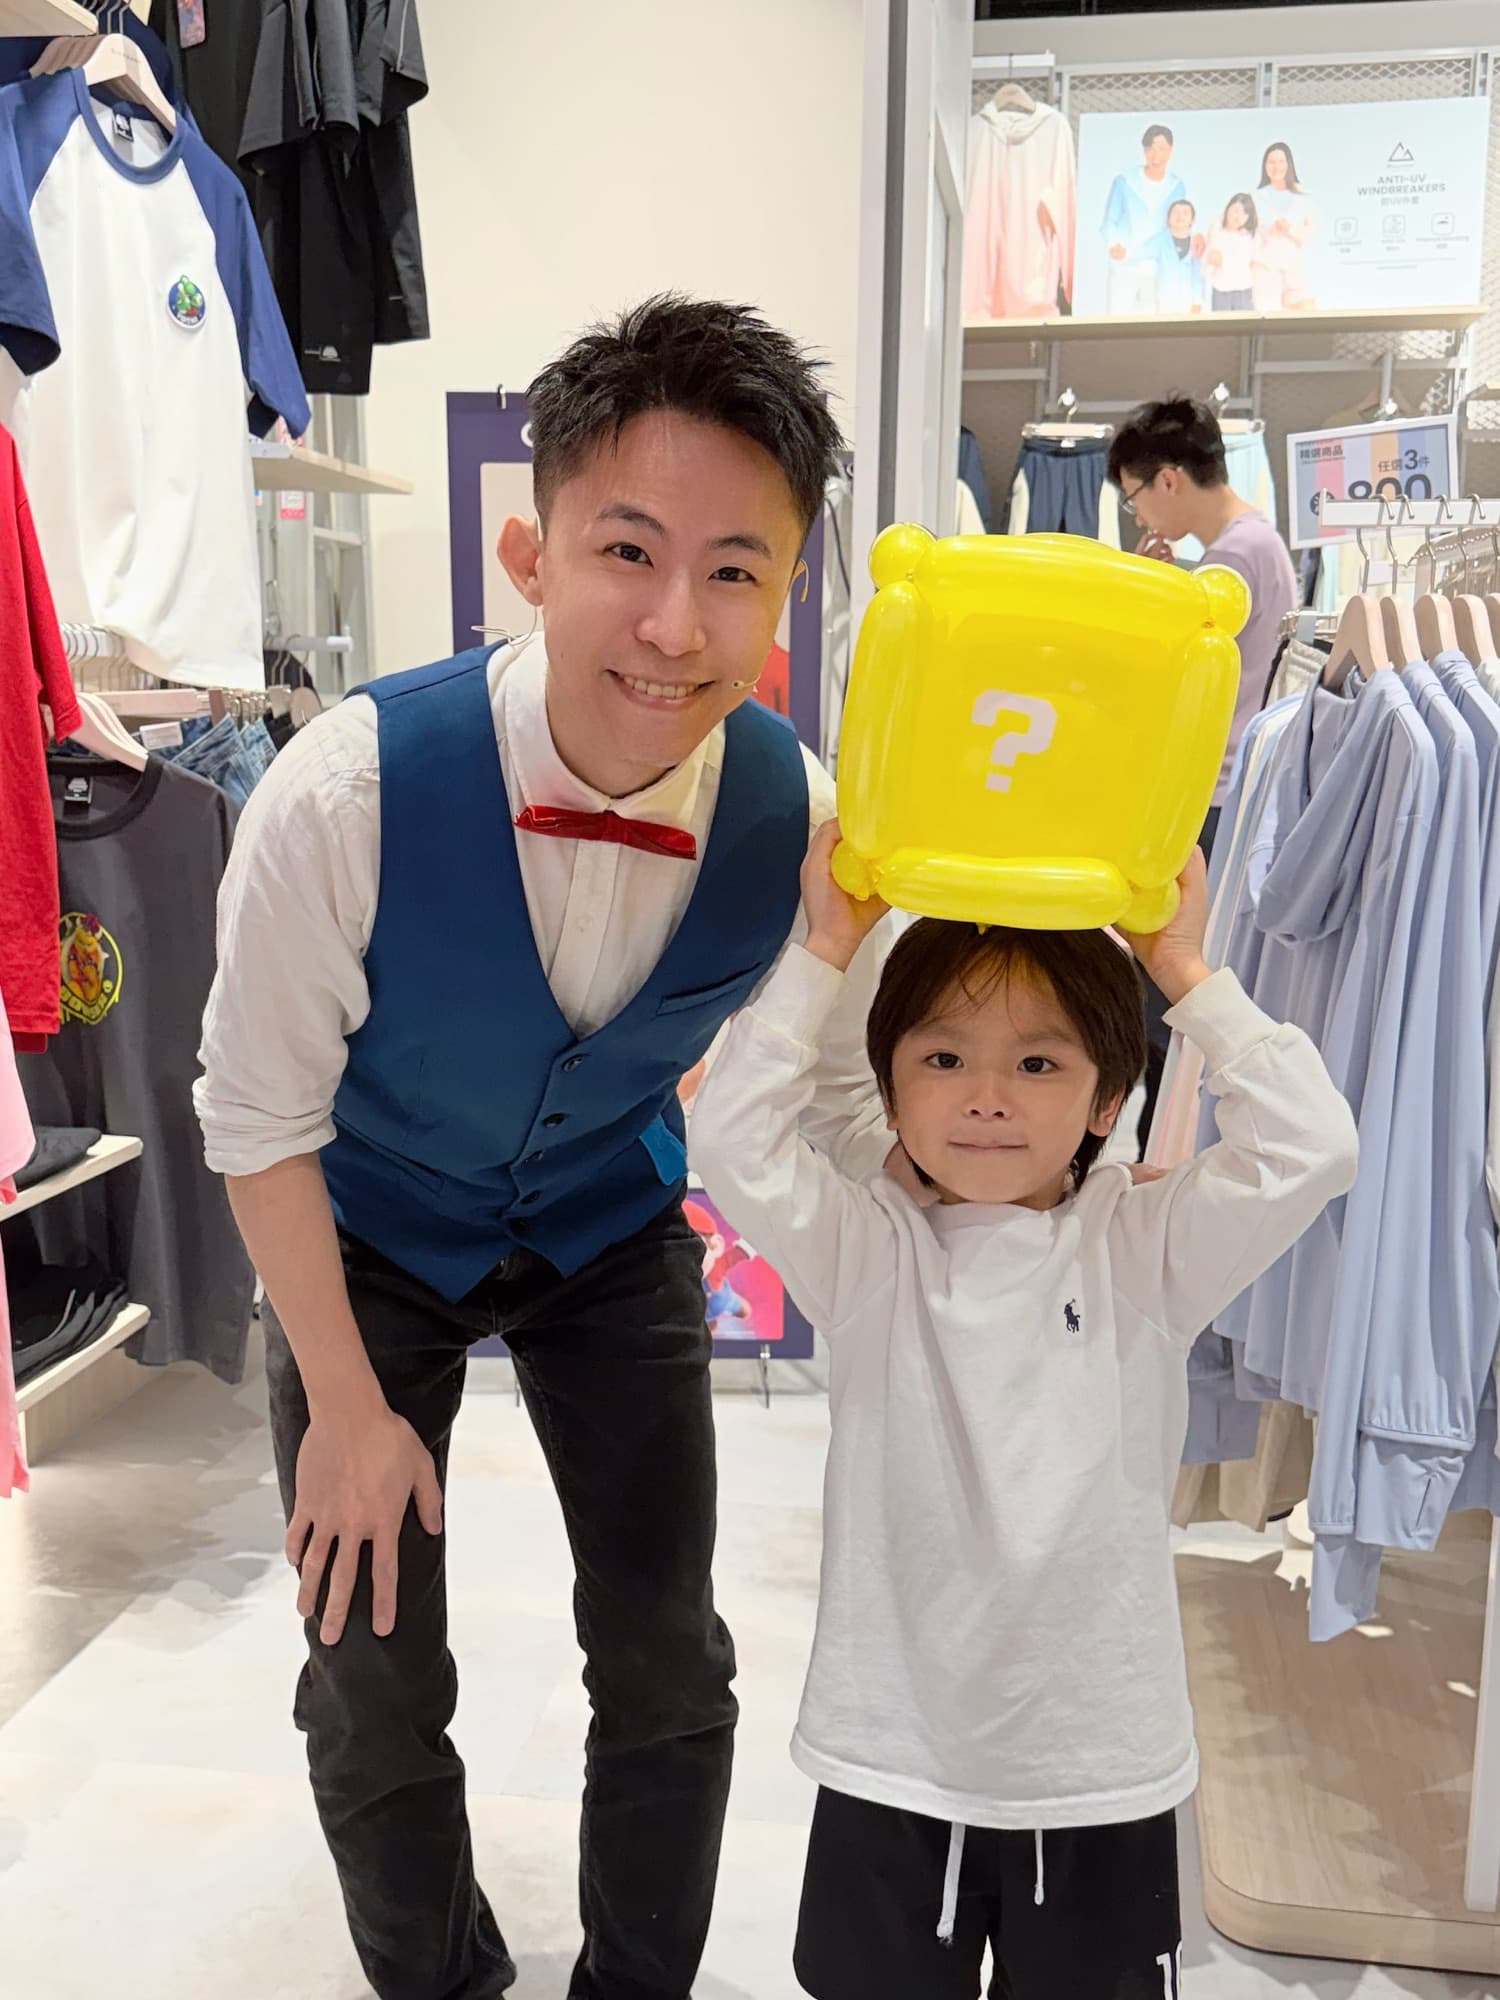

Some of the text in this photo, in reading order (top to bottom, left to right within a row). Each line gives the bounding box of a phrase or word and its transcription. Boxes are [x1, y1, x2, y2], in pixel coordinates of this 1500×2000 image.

[1377, 174, 1427, 185] ANTI-UV
[1357, 183, 1446, 196] WINDBREAKERS
[971, 688, 1057, 794] ?
